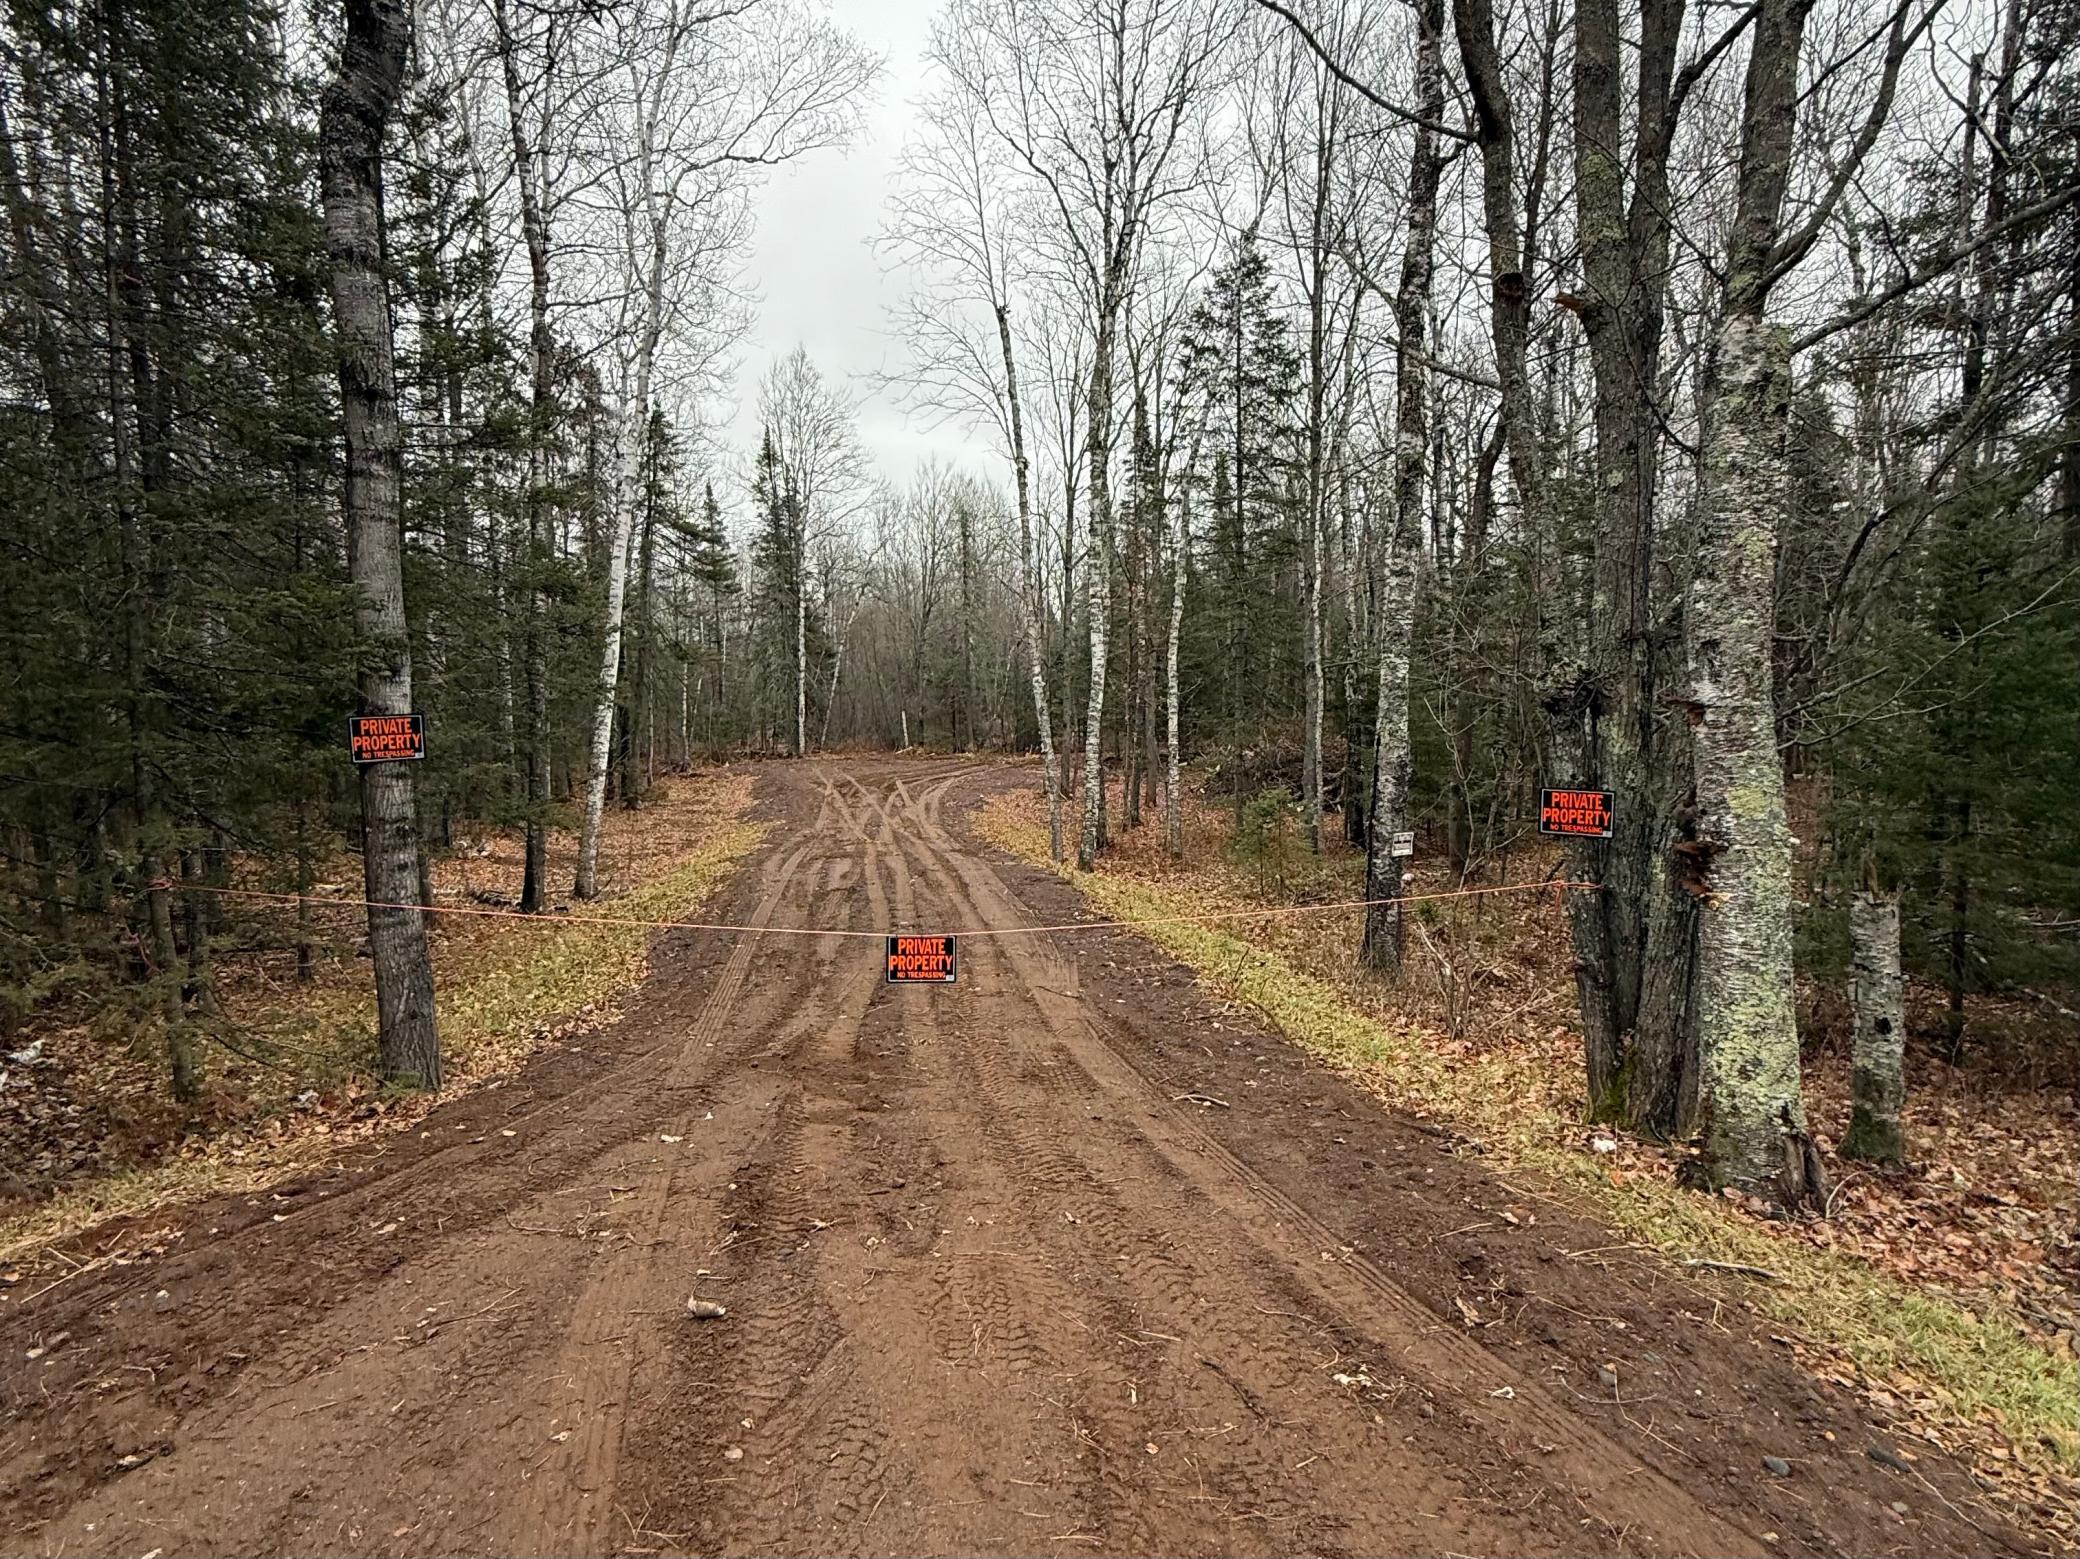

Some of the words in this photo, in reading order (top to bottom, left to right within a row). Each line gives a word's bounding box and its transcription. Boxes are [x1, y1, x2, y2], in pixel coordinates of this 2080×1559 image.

[360, 718, 412, 735] PRIVATE
[353, 733, 420, 751] PROPERTY
[374, 749, 415, 758] TRESPASSING
[1551, 792, 1603, 810] PRIVATE
[1543, 807, 1611, 826] PROPERTY
[1561, 824, 1603, 833] TRESPASSING
[898, 939, 946, 954] PRIVATE
[890, 955, 953, 970] PROPERTY
